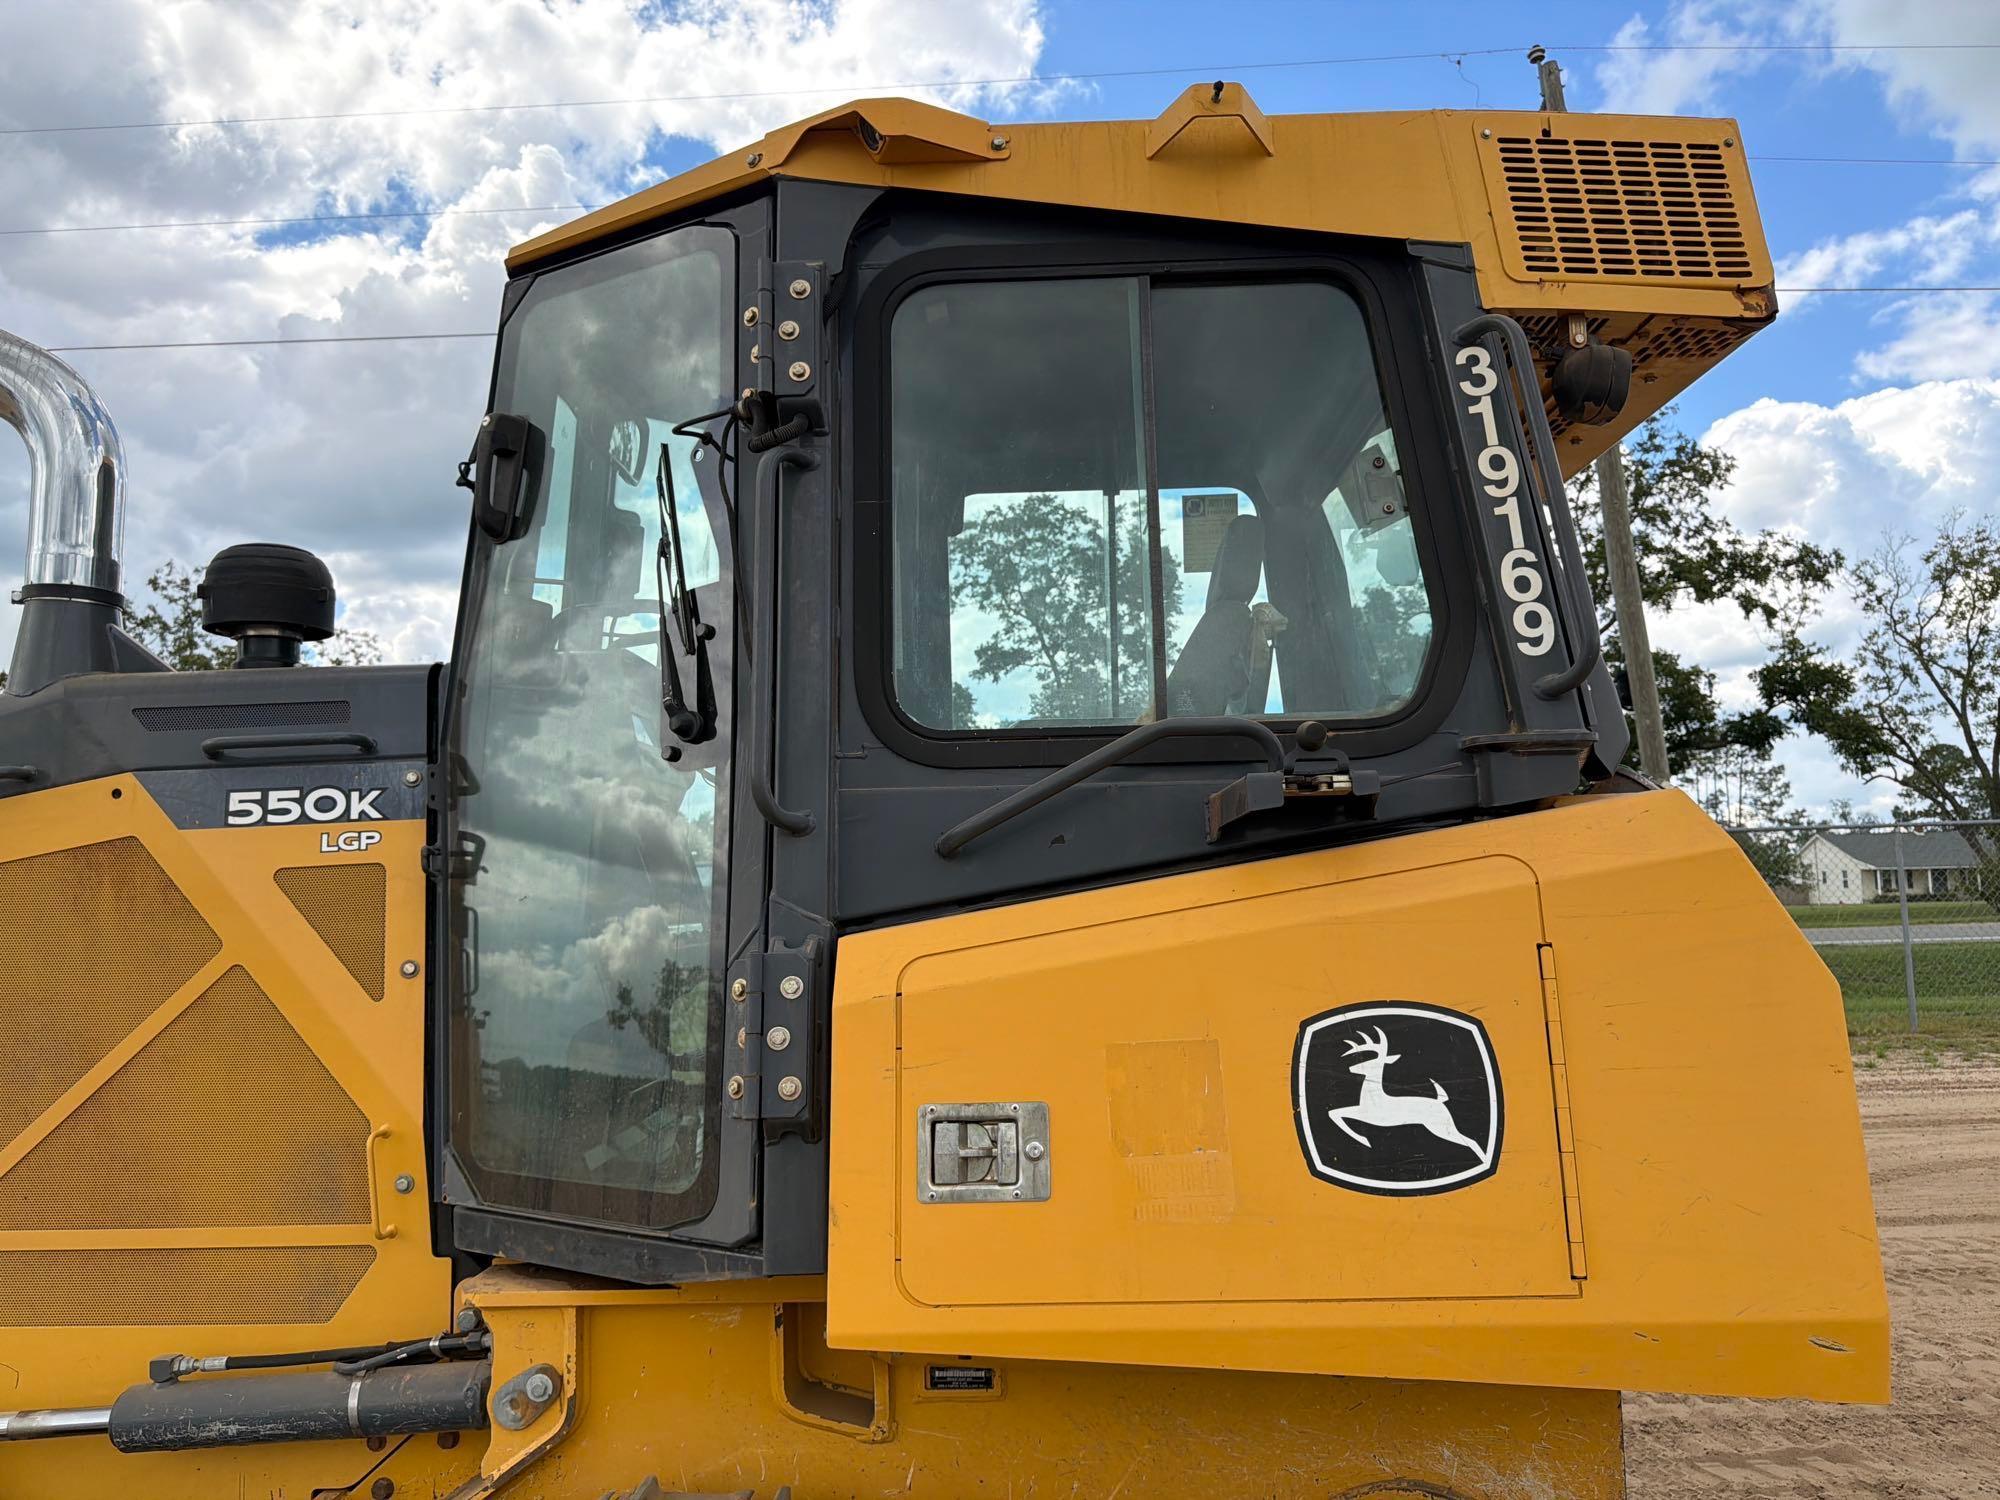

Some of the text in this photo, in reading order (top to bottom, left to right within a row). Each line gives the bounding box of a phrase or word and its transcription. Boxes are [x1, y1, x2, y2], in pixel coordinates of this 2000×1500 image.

[1455, 346, 1555, 656] 319169
[226, 787, 384, 825] 550K
[320, 831, 380, 852] LGP
